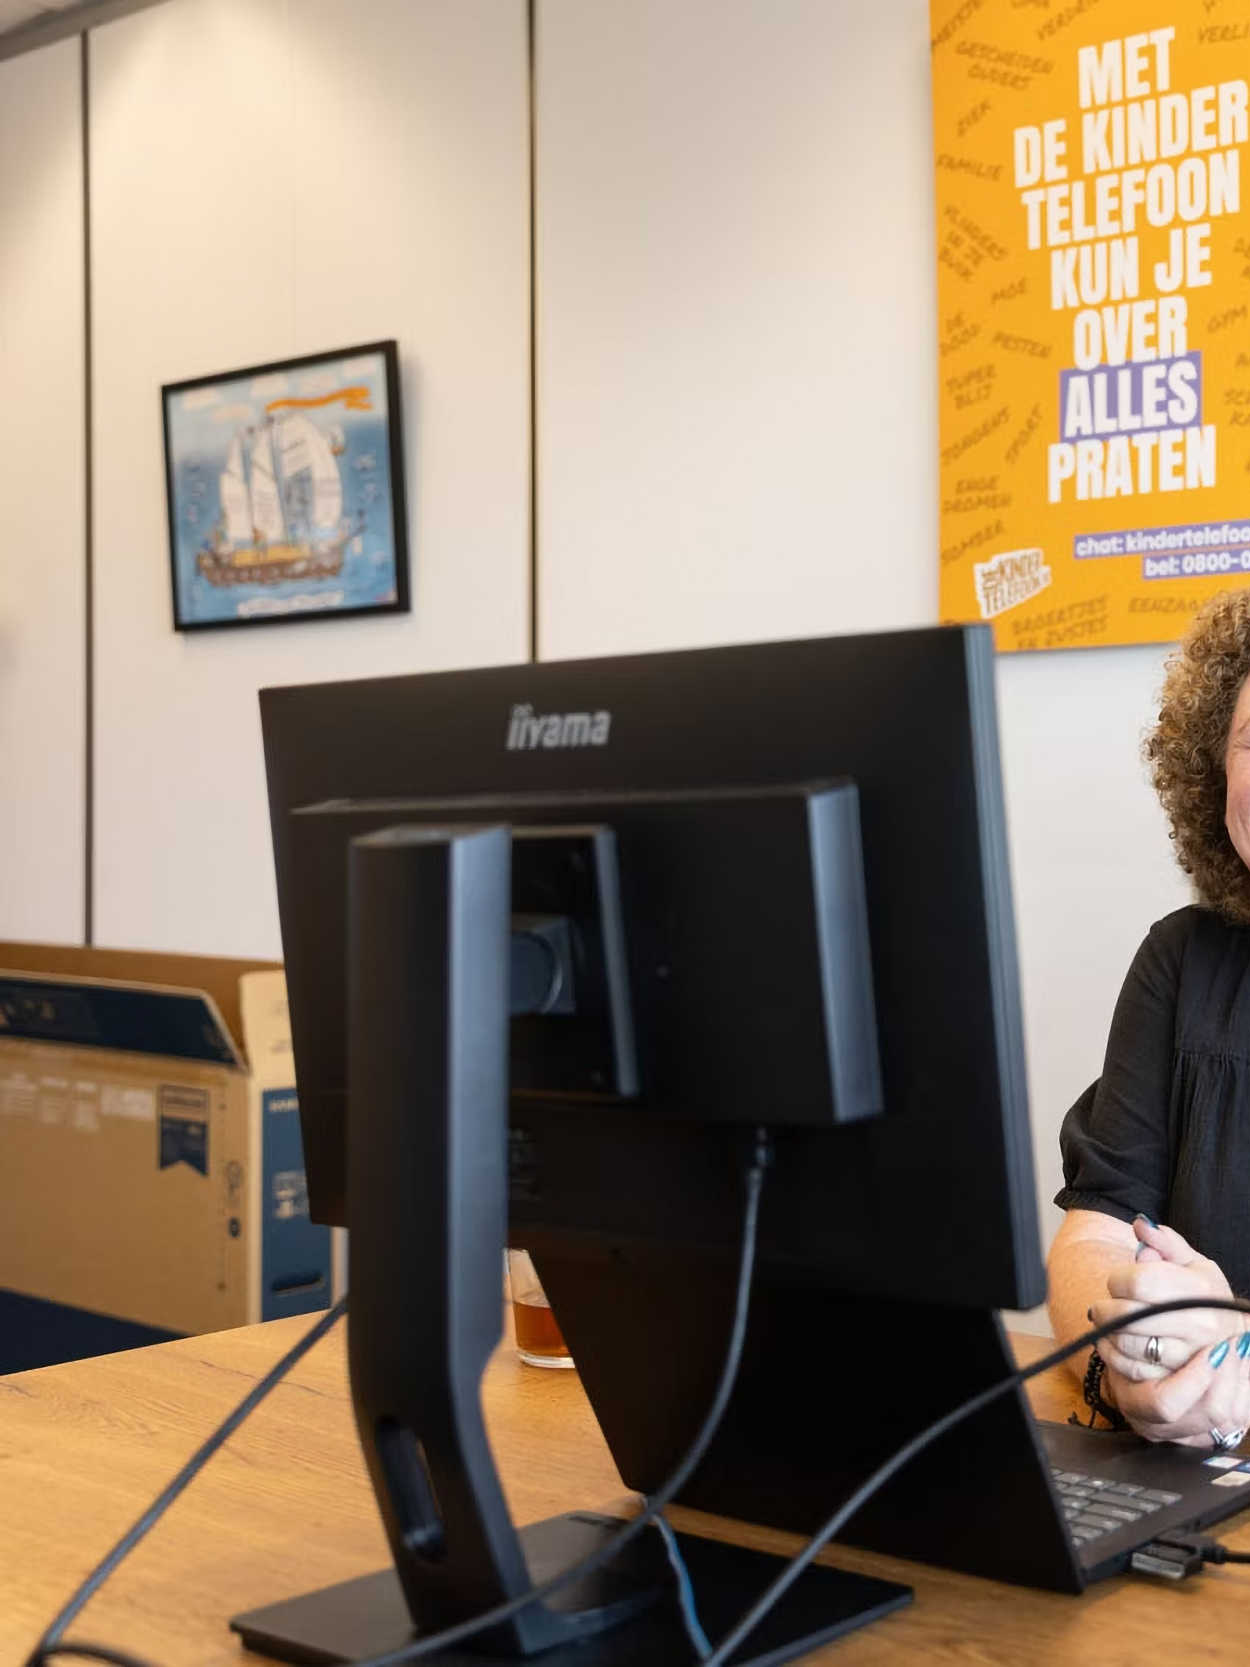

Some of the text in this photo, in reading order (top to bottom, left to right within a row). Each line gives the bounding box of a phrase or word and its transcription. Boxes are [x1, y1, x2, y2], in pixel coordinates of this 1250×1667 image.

[1077, 26, 1175, 109] MET
[936, 153, 1003, 182] FAMILIE
[1013, 80, 1249, 188] DE KINDER
[1021, 149, 1241, 250] TELEFOON
[1051, 223, 1213, 310] KUN JE
[992, 331, 1053, 359] PESTEN
[1073, 295, 1188, 371] OVER
[1206, 303, 1249, 335] GYM
[1064, 361, 1199, 439] ALLES
[1048, 424, 1217, 504] PRATEN
[1075, 536, 1124, 557] chat:
[1144, 556, 1181, 577] bel:
